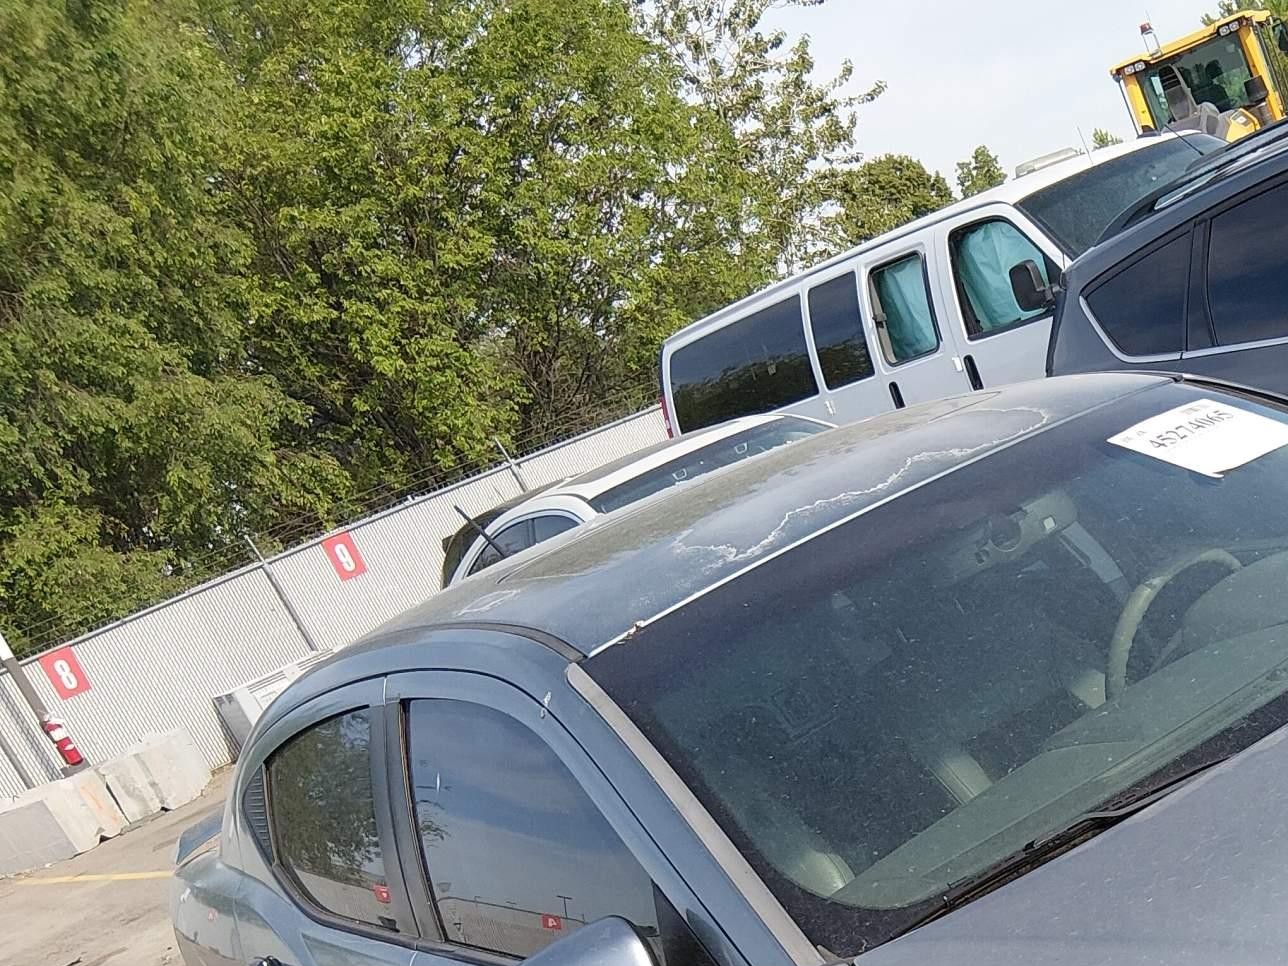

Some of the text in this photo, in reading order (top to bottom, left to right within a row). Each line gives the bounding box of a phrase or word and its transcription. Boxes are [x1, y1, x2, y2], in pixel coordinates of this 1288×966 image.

[1148, 409, 1235, 449] 45274065
[334, 543, 356, 572] 9
[53, 659, 78, 690] 8
